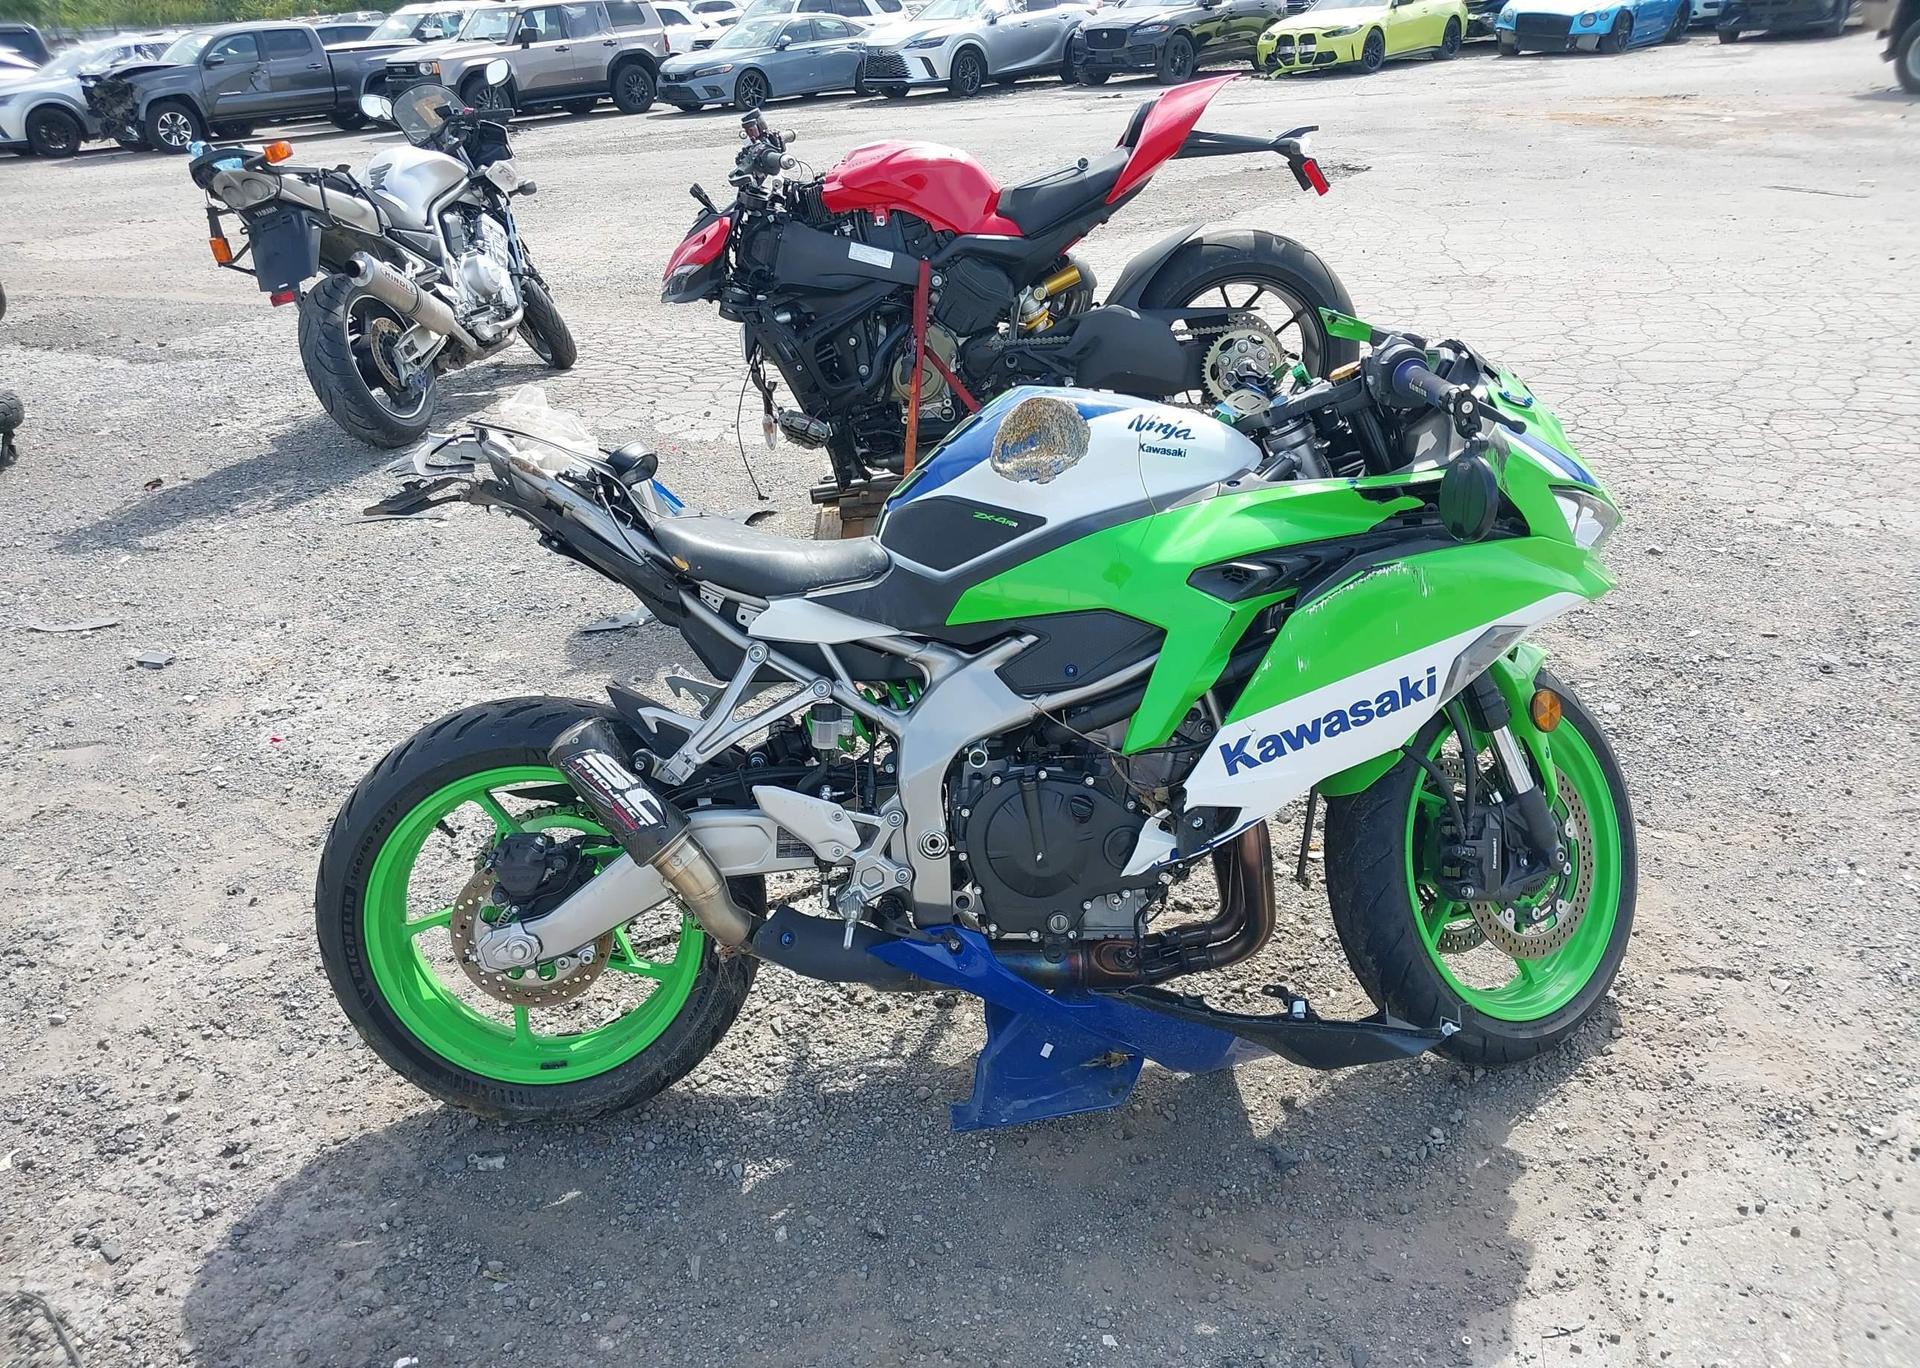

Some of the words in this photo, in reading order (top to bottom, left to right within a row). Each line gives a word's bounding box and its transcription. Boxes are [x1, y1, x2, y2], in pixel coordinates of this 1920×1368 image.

[1127, 413, 1196, 442] Ninja
[1139, 442, 1187, 458] Kawasaki
[1219, 666, 1437, 777] Kawasaki
[574, 757, 650, 827] PROJECT
[343, 889, 363, 980] MICHELIN
